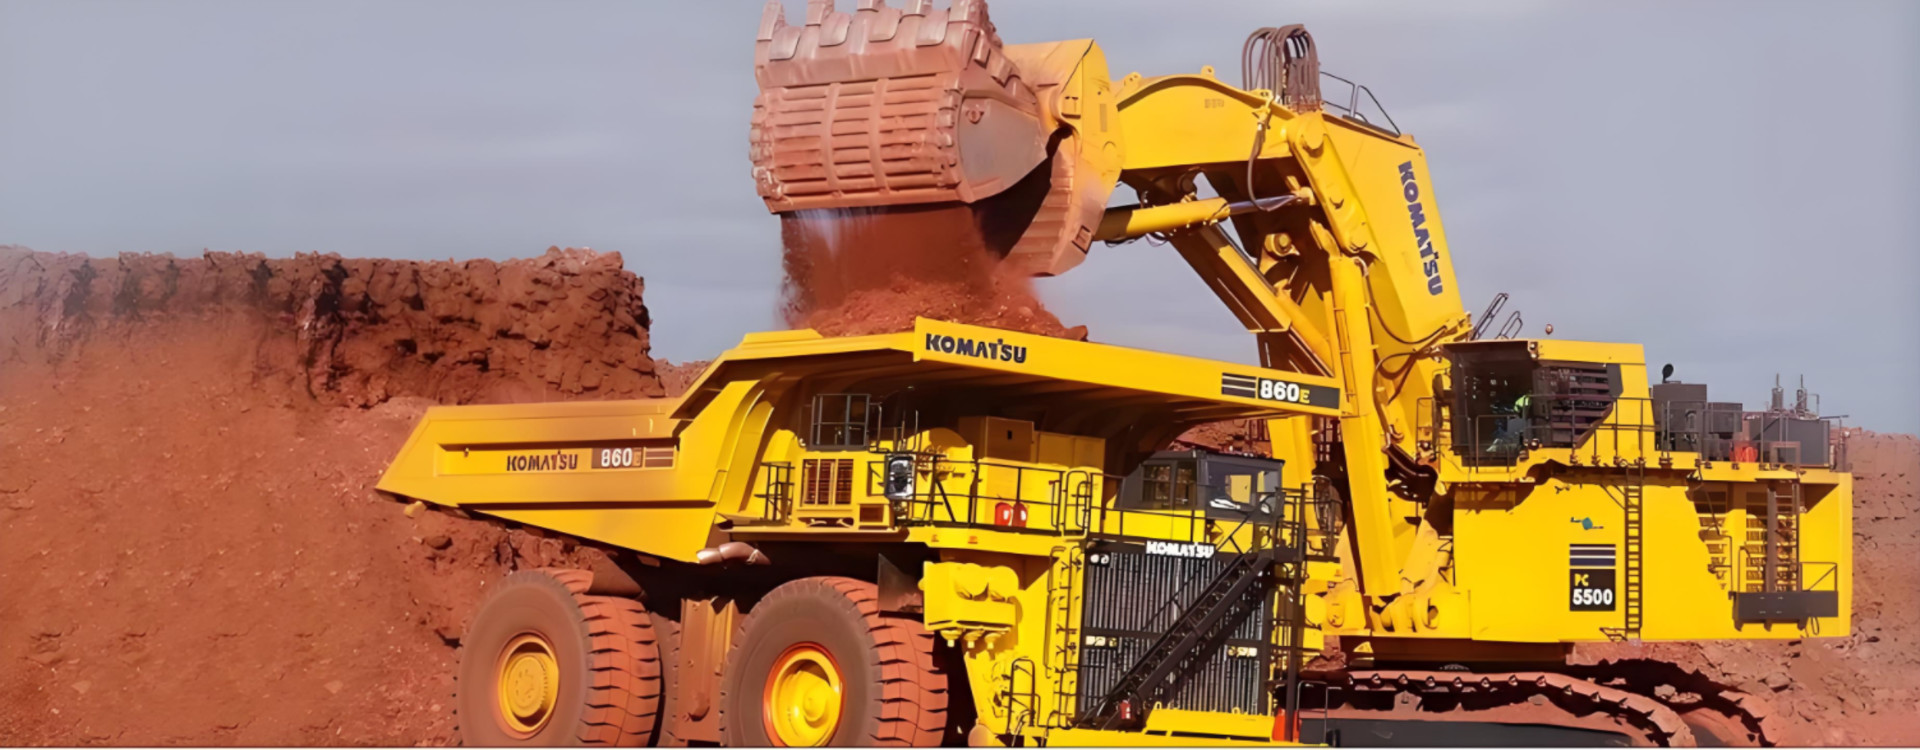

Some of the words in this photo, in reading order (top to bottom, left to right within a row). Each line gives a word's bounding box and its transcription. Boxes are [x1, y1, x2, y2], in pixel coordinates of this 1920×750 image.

[1398, 160, 1443, 296] KOMATSU
[926, 332, 1027, 363] KOMATSU
[1260, 380, 1310, 404] 860E
[506, 450, 578, 471] KOMATSU
[1146, 540, 1214, 559] KOMATSU
[1574, 573, 1589, 587] PC
[1572, 588, 1613, 605] 5500
